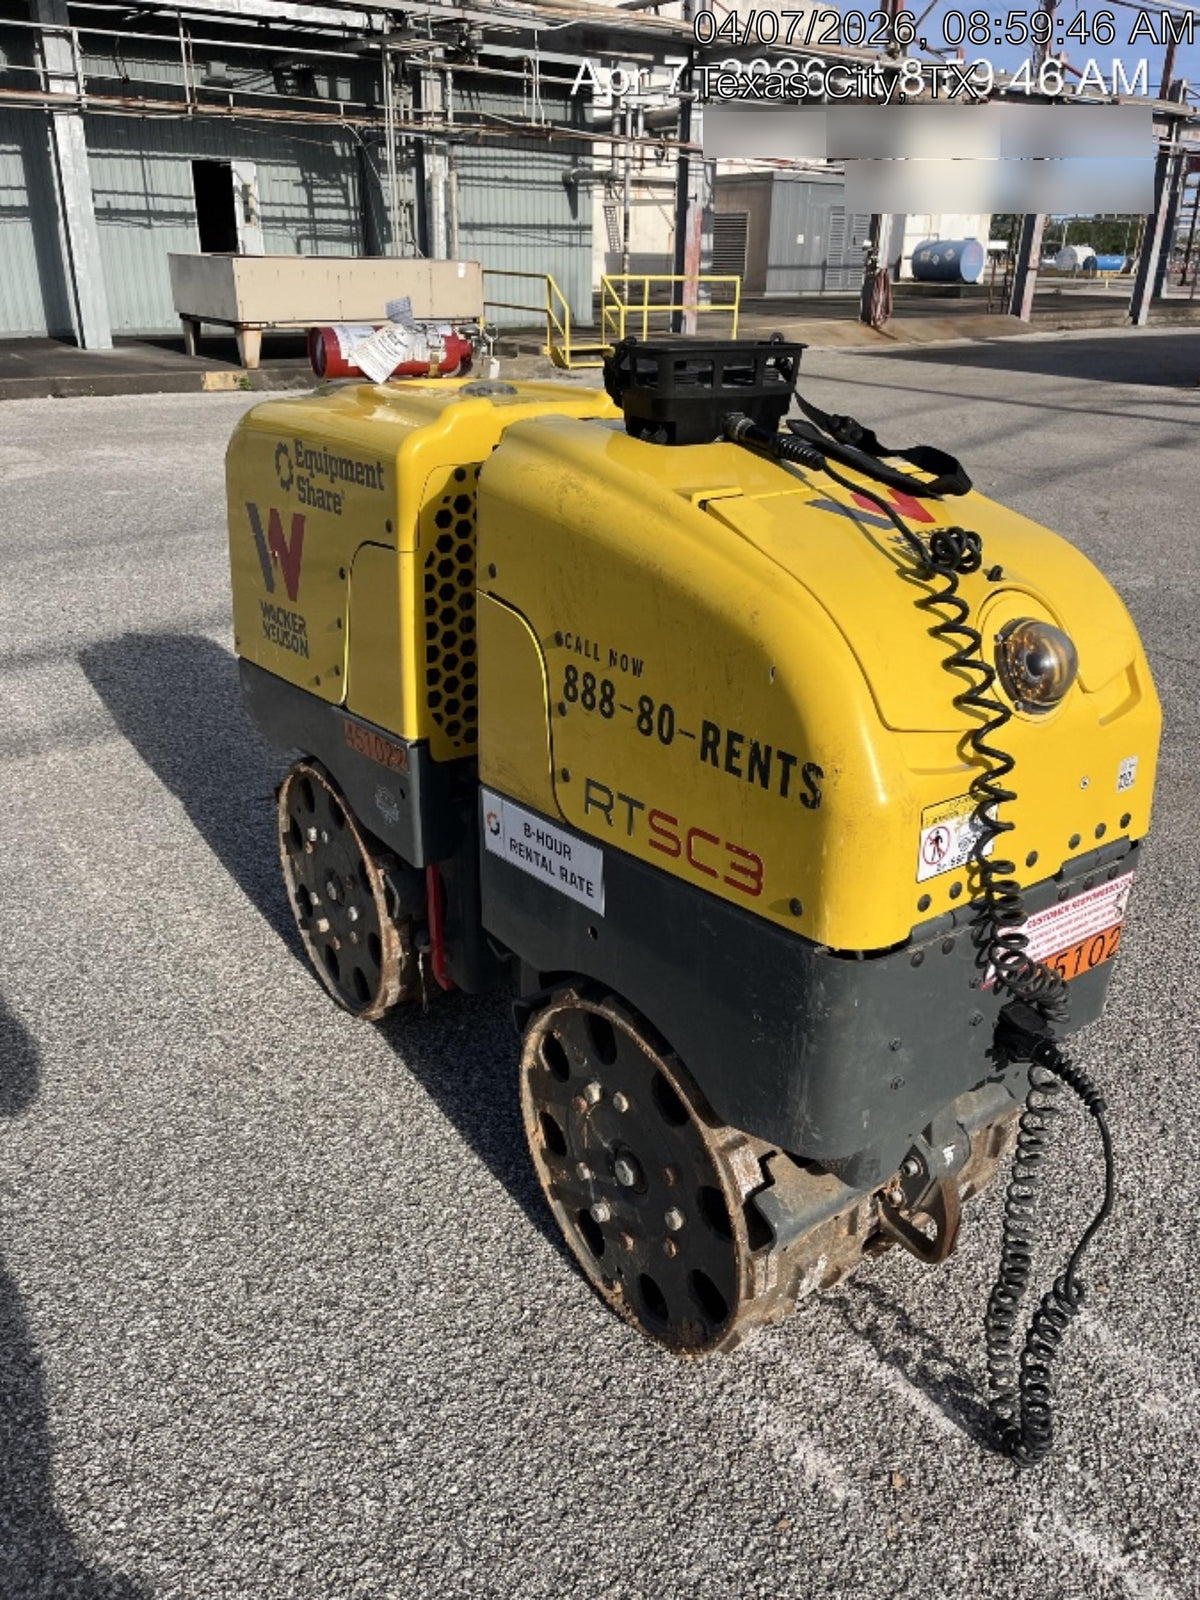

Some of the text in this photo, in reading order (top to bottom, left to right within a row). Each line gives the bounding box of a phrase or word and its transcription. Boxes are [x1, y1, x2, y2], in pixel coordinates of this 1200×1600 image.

[293, 438, 384, 491] Equipment
[297, 475, 342, 516] Share
[259, 599, 308, 638] WACKER
[262, 620, 310, 660] NEUSON
[564, 632, 644, 678] CALL NOW
[563, 664, 825, 809] 888-80-RENTS
[584, 777, 764, 897] RTSC3
[509, 837, 595, 899] RENTAL RATE
[1044, 926, 1122, 979] 5102
